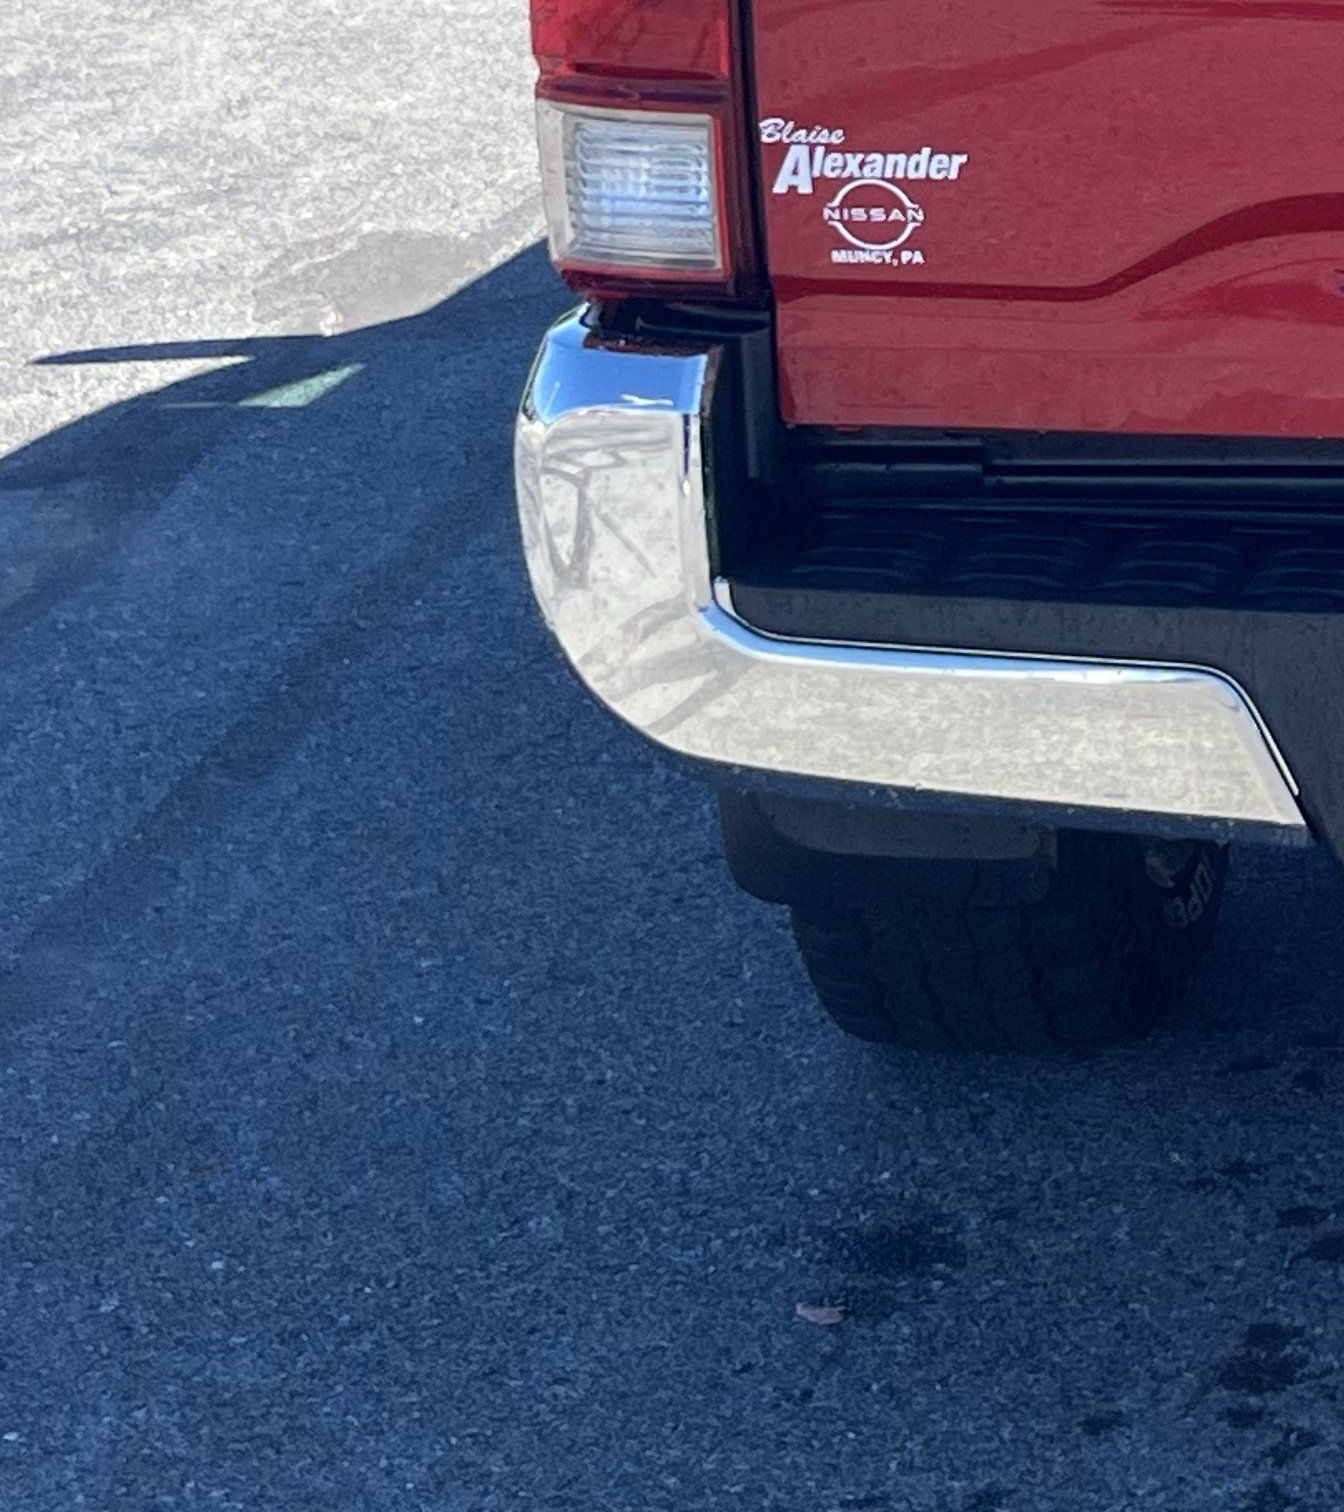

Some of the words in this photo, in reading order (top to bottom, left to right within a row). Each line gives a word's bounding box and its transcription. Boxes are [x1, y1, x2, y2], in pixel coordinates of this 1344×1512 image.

[758, 118, 845, 144] Blaise
[772, 145, 968, 194] Alexander
[823, 207, 924, 222] NISSAN
[830, 249, 898, 266] MUNCY,
[902, 250, 924, 264] PA
